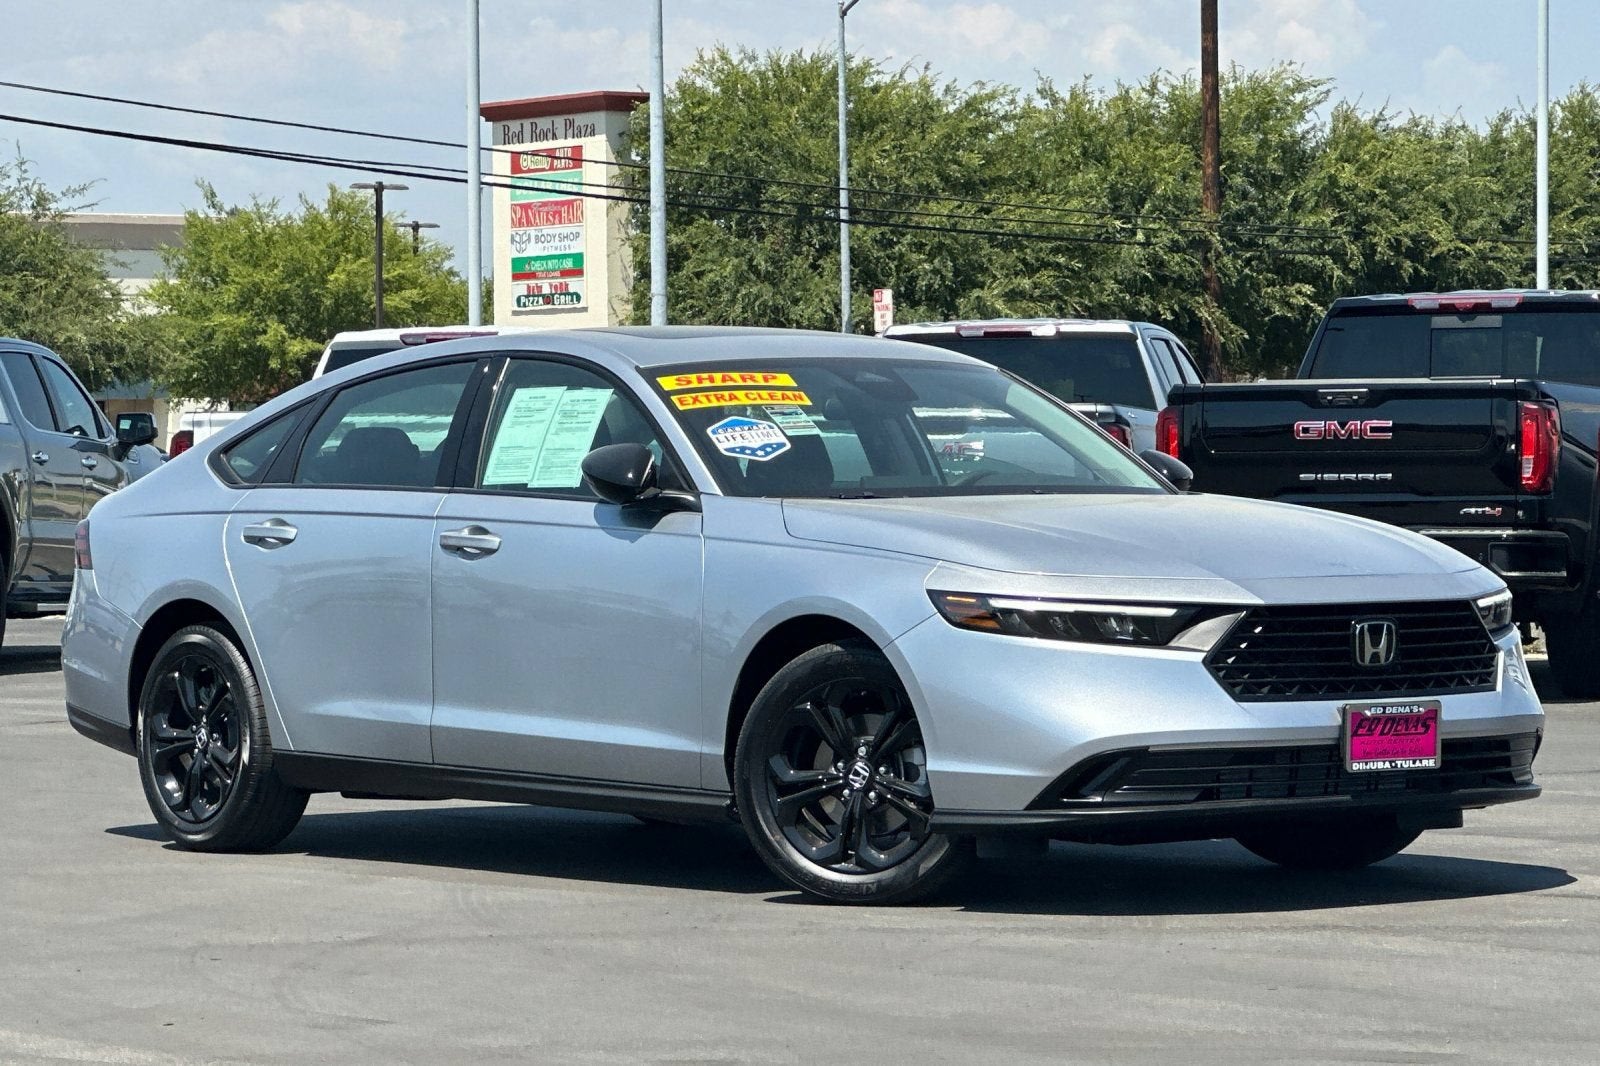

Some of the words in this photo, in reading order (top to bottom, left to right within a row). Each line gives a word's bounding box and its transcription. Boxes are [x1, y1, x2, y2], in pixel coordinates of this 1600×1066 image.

[502, 122, 524, 145] Red
[530, 120, 558, 143] Rock
[564, 118, 596, 140] Plaza
[555, 147, 572, 158] AUTO
[553, 158, 574, 169] PARTS
[511, 204, 527, 228] SPA
[528, 208, 554, 227] NAILS
[561, 200, 583, 224] HAIR
[534, 233, 557, 244] BODY
[558, 231, 580, 242] SHOP
[543, 244, 571, 252] FITNESS
[530, 260, 547, 271] CHECK
[547, 259, 558, 270] INTO
[559, 258, 573, 269] CASH
[526, 282, 543, 295] NEW
[549, 281, 569, 294] YORK
[553, 294, 578, 305] GRILL
[674, 373, 779, 387] SHARP
[677, 393, 740, 407] EXTRA
[745, 391, 806, 403] CLEAN
[715, 429, 781, 443] LIFETIME
[1294, 420, 1393, 440] GMC
[1299, 473, 1393, 481] SIERRA
[1459, 506, 1502, 517] AT4
[1386, 705, 1419, 714] DENA'S
[1395, 759, 1436, 768] TULARE
